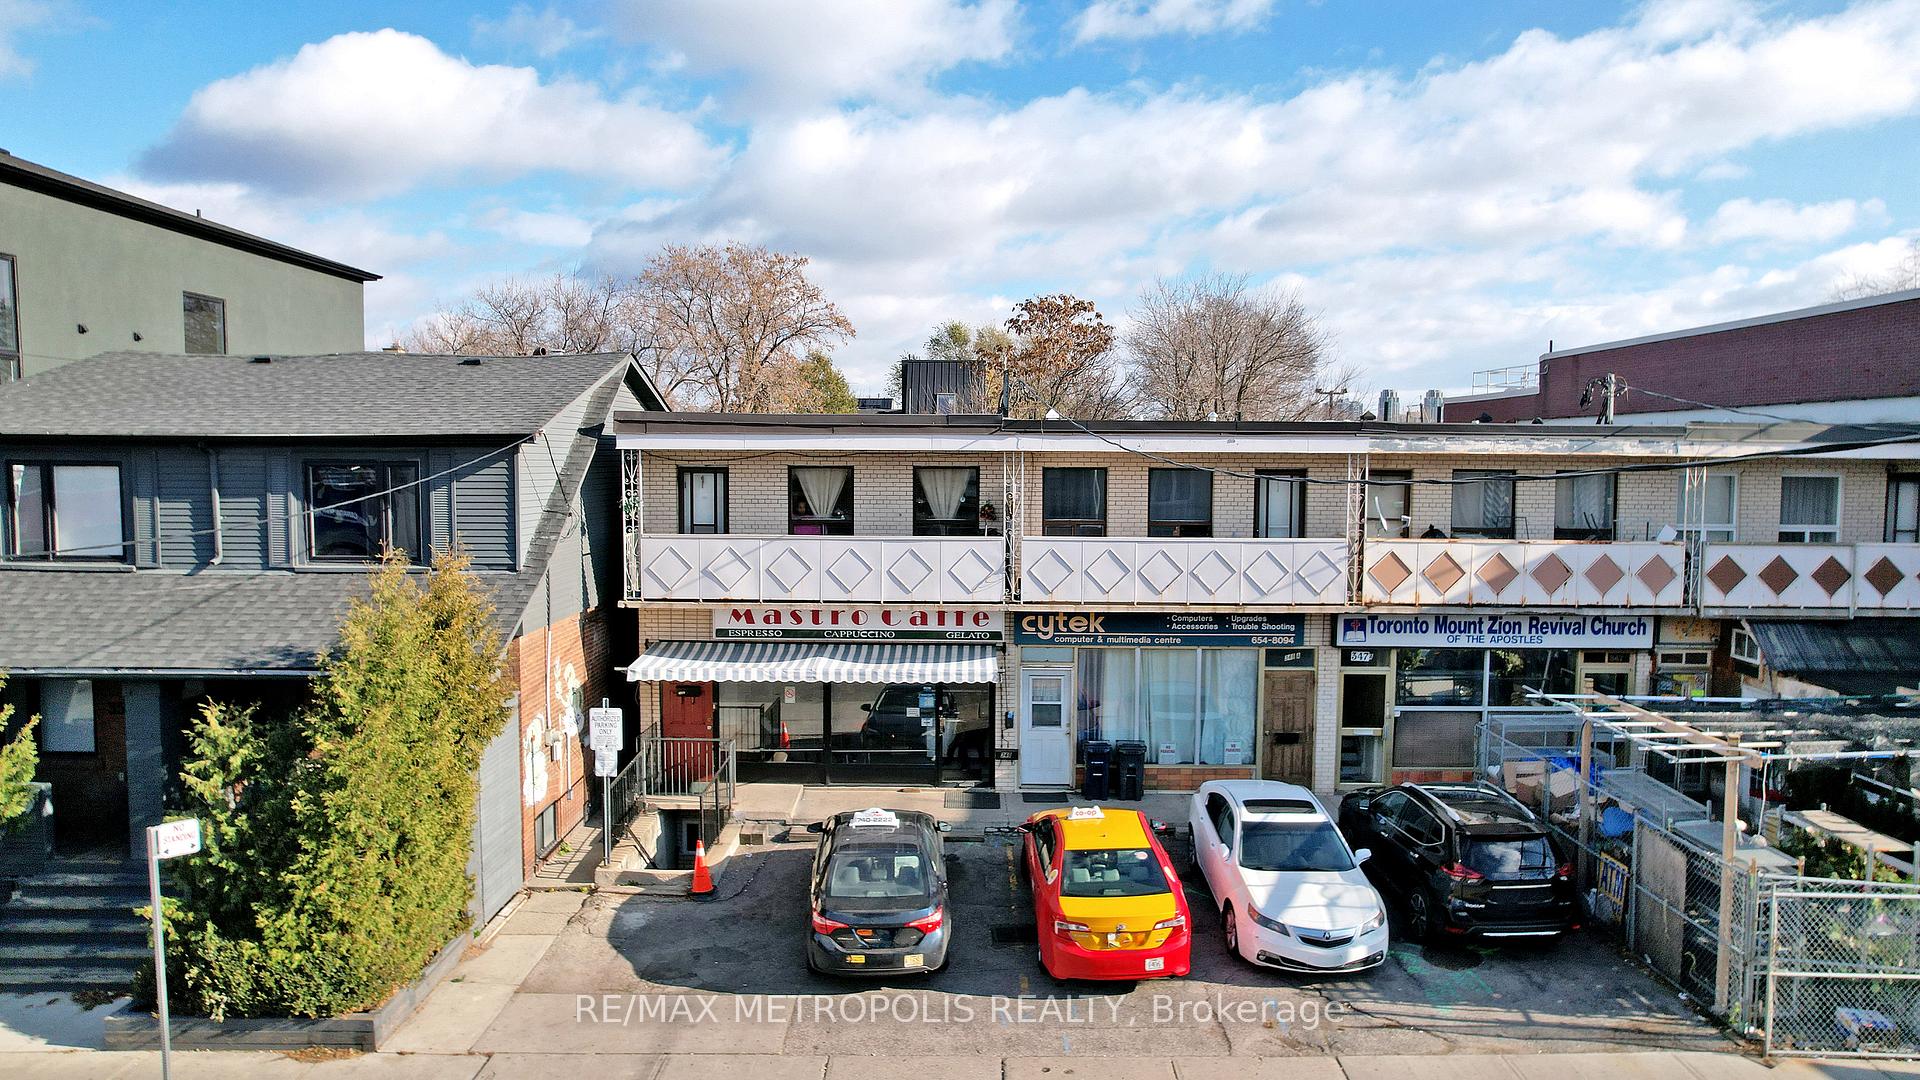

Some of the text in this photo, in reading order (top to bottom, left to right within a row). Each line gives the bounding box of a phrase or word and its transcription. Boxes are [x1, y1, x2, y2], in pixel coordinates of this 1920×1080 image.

[728, 608, 869, 626] Mastro
[1171, 614, 1213, 623] Computers
[1231, 615, 1268, 624] Upgrades
[1021, 612, 1106, 640] cytek
[1171, 623, 1219, 631] Accessories
[1231, 623, 1296, 632] Trouble Shooting
[1367, 615, 1647, 636] Toronto Mount Zion Revival Church
[728, 629, 783, 638] ESPRESSO
[824, 630, 896, 639] CAPPUCCINO
[945, 631, 990, 640] GELATO
[1054, 635, 1182, 645] computer & multimedia centre
[1251, 636, 1295, 645] 654-8094
[1446, 635, 1543, 645] OF THE APOSTLES
